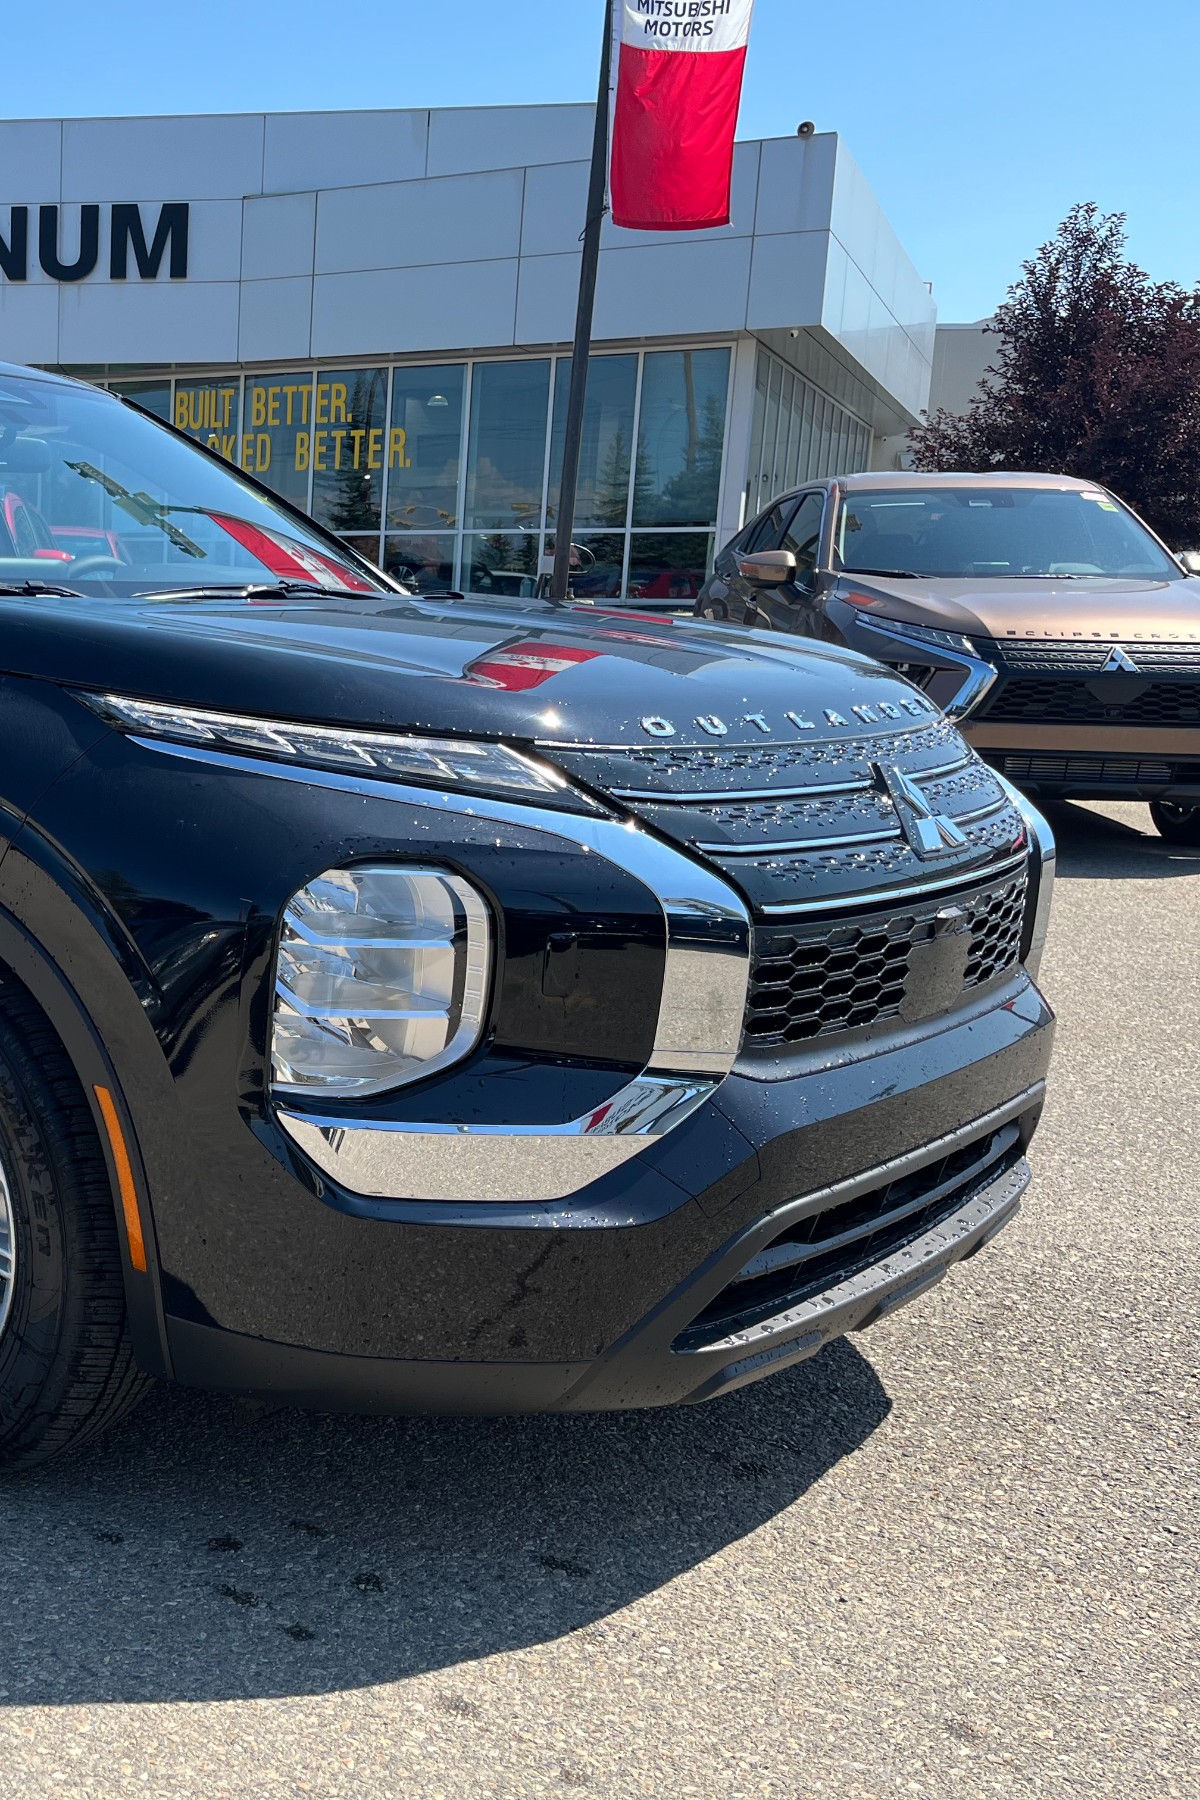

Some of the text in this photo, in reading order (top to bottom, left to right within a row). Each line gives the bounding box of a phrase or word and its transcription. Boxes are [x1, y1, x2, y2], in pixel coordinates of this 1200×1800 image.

[637, 0, 731, 17] MITSUBISHI
[644, 19, 714, 37] MOTORS
[174, 383, 352, 430] BUILT BETTER.
[294, 428, 411, 471] BETTER.
[1006, 630, 1120, 638] ECLIPSE
[639, 695, 935, 738] OUTLANDER
